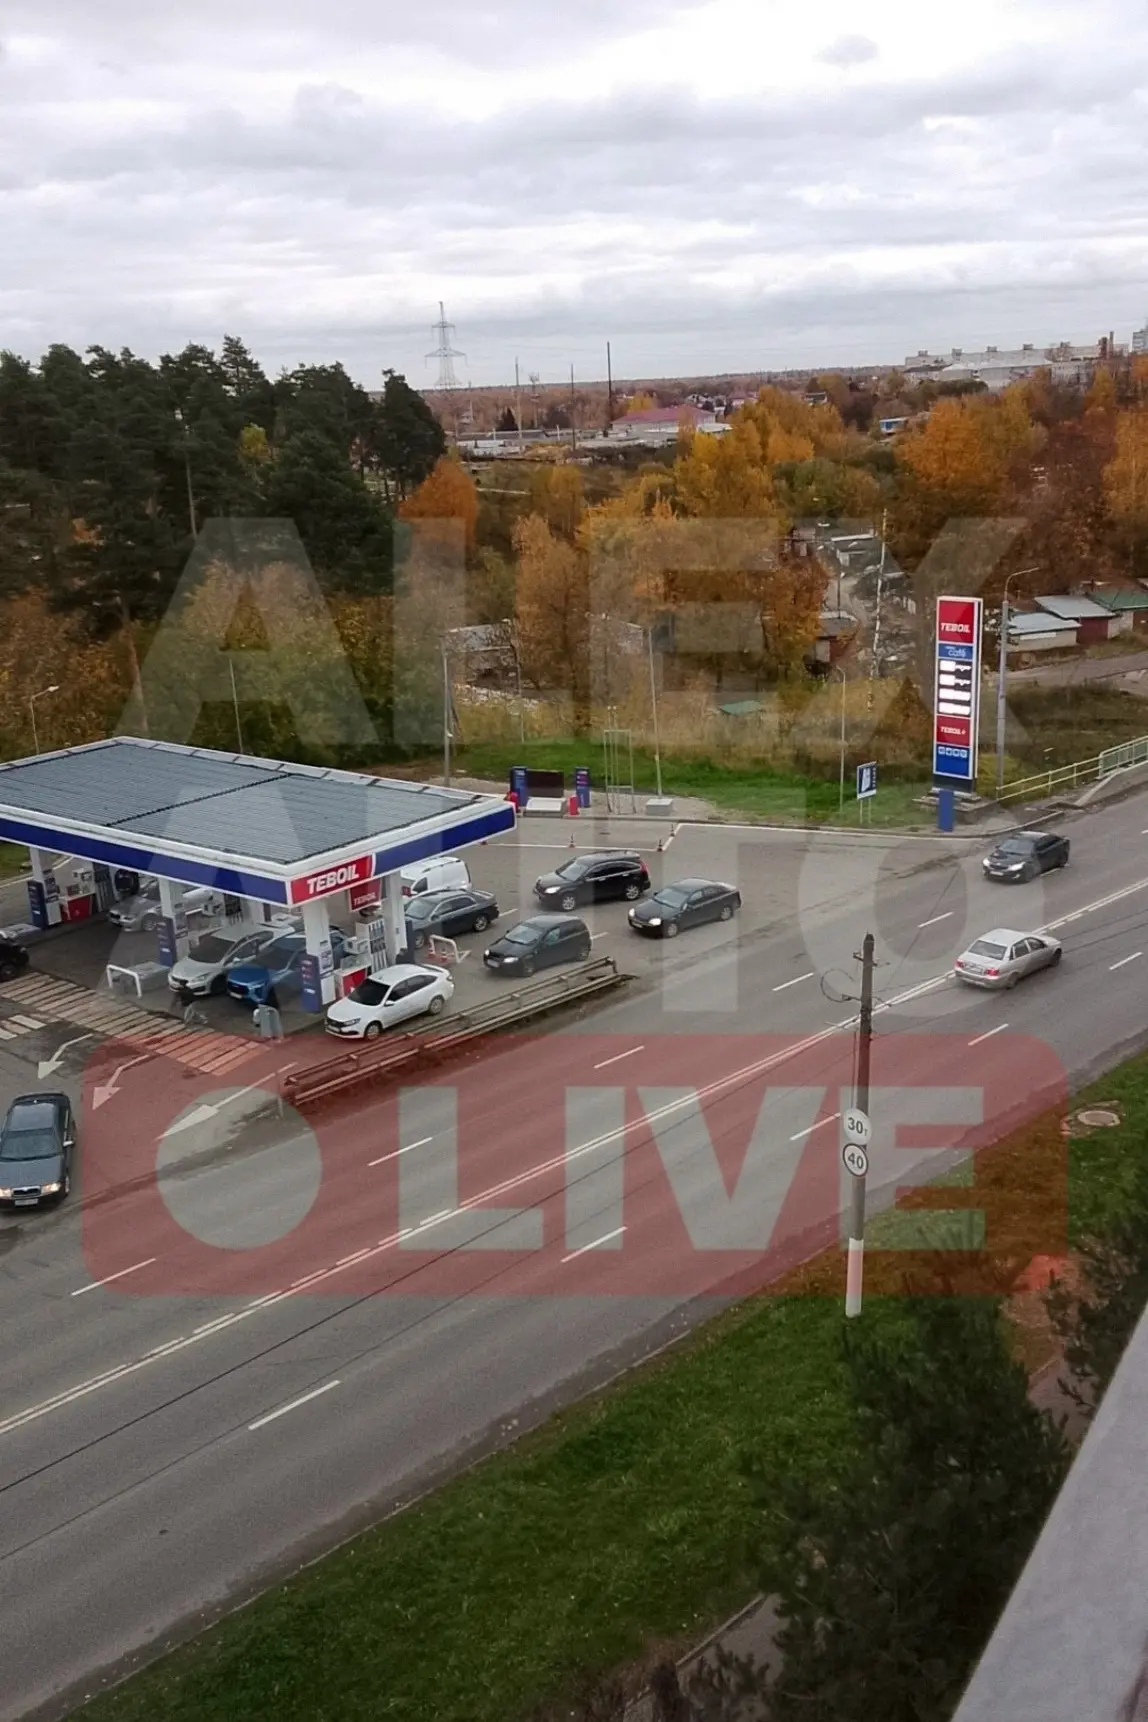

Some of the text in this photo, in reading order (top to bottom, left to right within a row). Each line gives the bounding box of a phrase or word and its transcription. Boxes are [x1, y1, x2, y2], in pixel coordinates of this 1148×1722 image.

[940, 622, 970, 633] TEBOIL
[306, 864, 359, 895] TEBOIL
[847, 1152, 864, 1169] 40
